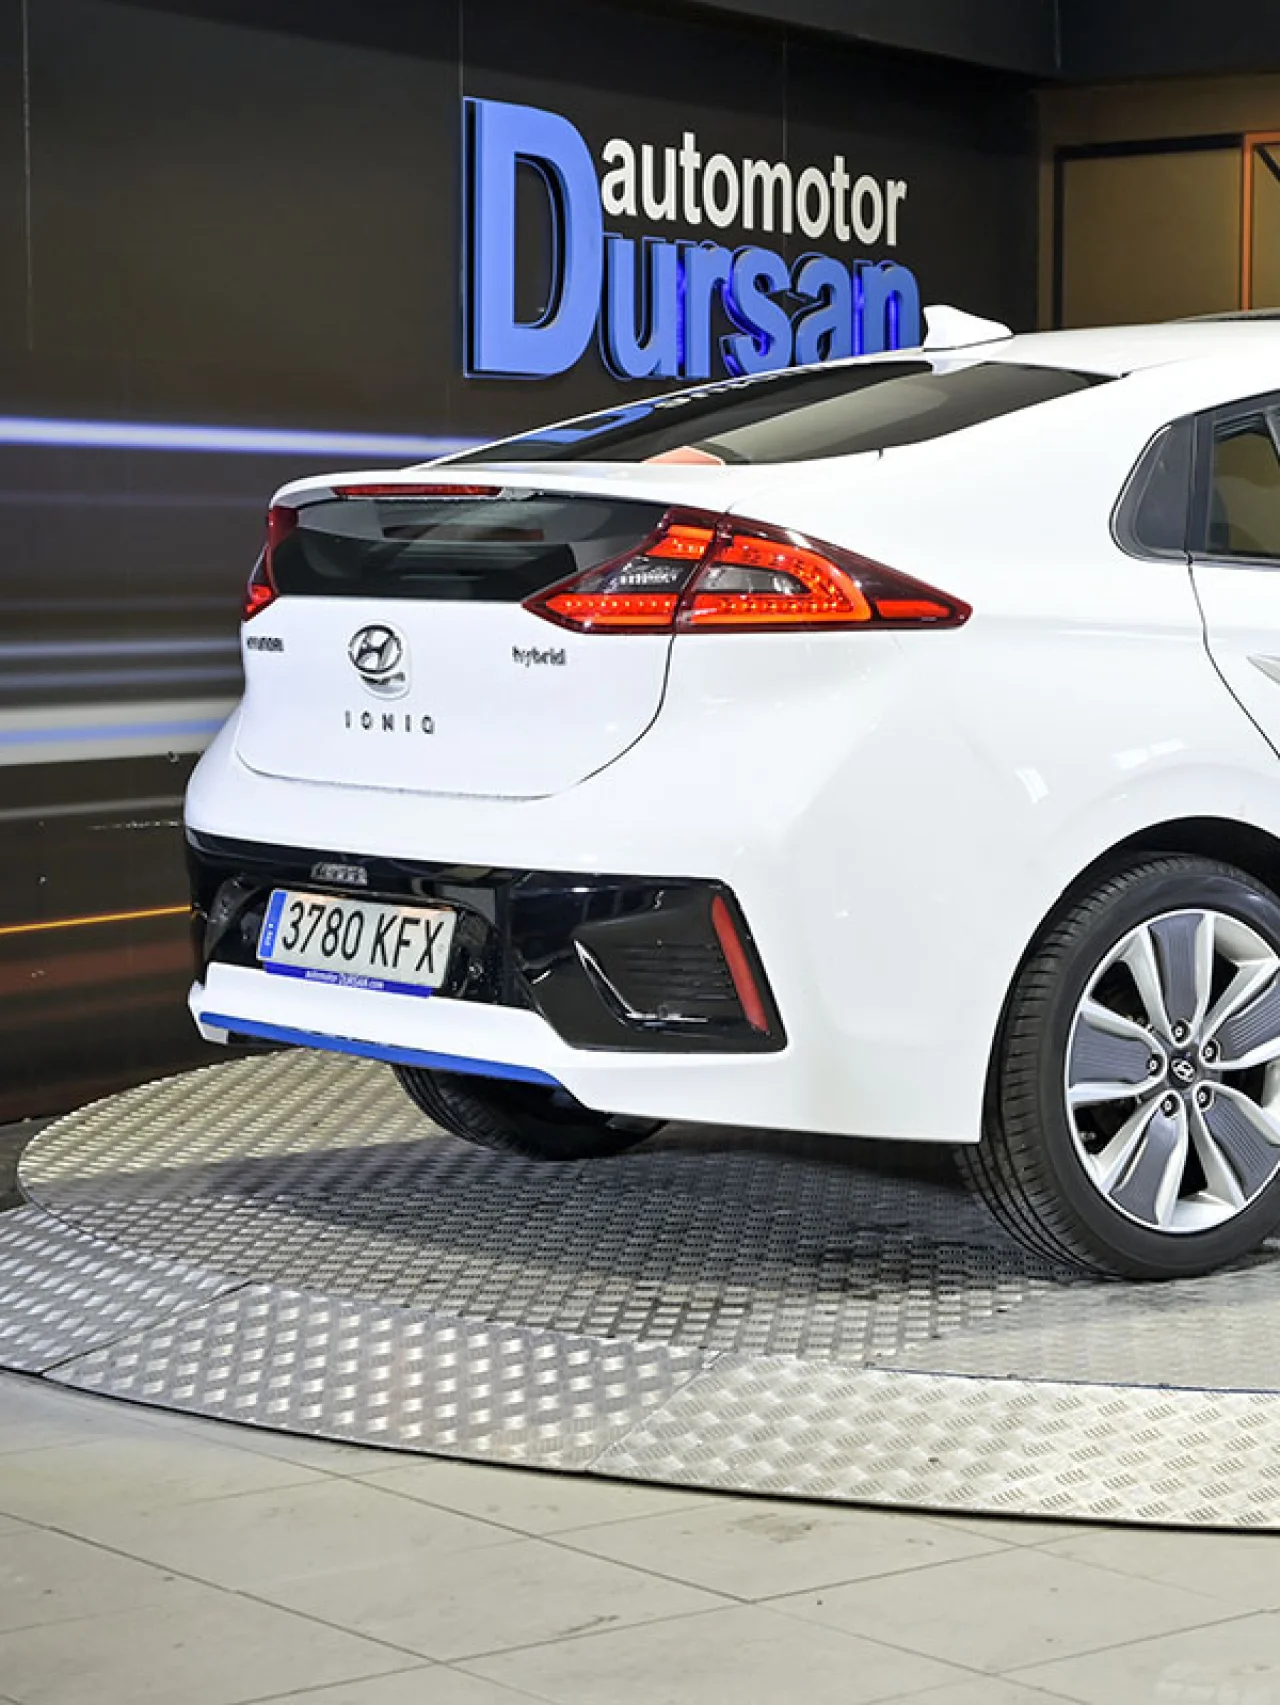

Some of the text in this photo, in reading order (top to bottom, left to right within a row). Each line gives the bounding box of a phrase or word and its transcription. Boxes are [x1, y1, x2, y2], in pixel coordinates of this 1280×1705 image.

[601, 131, 907, 246] automotor
[463, 95, 920, 380] Dursan
[512, 645, 566, 668] hybrid
[281, 900, 445, 974] 3780 KFX
